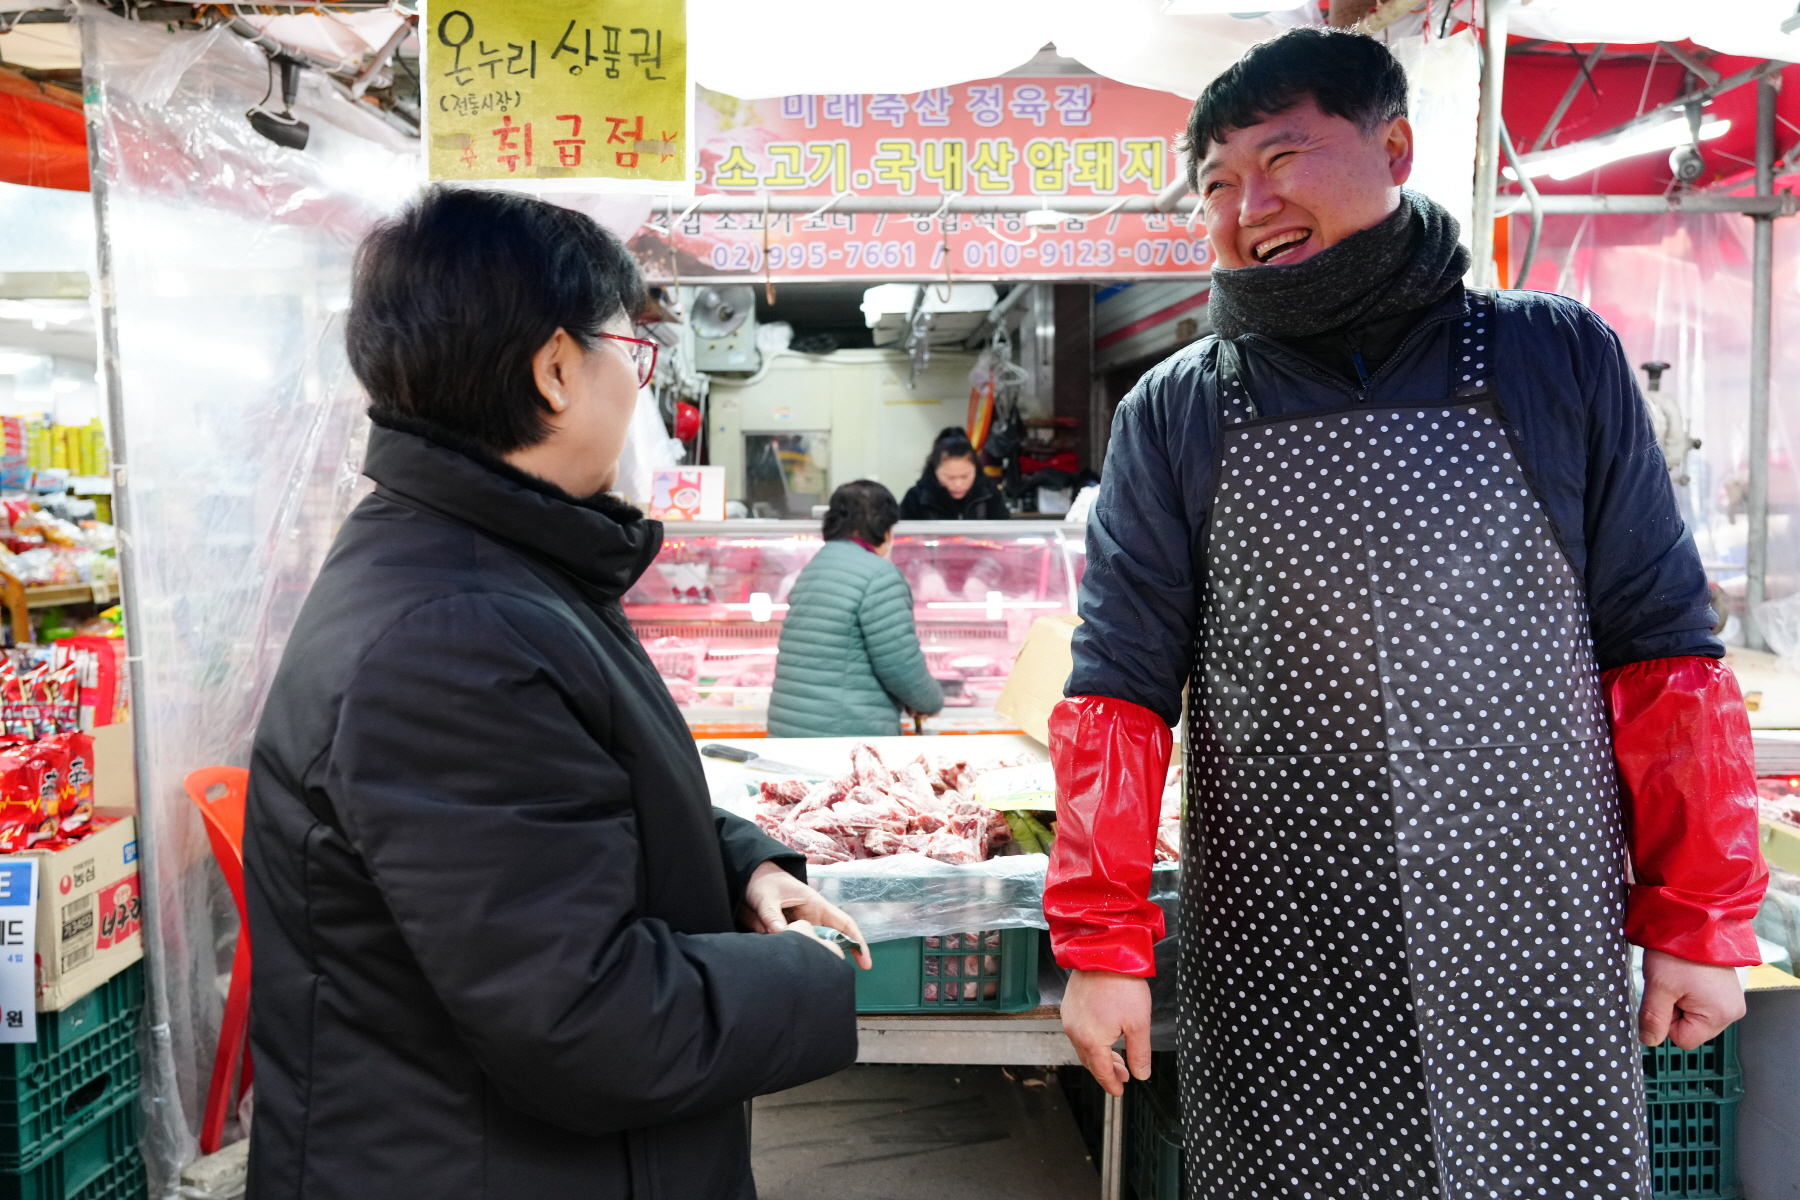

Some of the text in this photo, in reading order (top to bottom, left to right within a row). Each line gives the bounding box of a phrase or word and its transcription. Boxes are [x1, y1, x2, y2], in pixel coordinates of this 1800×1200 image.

[438, 10, 666, 86] 온누리 상품권
[440, 90, 521, 116] (전통시장)
[783, 85, 1092, 127] 미래축산 정육점
[713, 243, 915, 271] 02)995-7661
[965, 241, 1208, 268] 010-9123-0706
